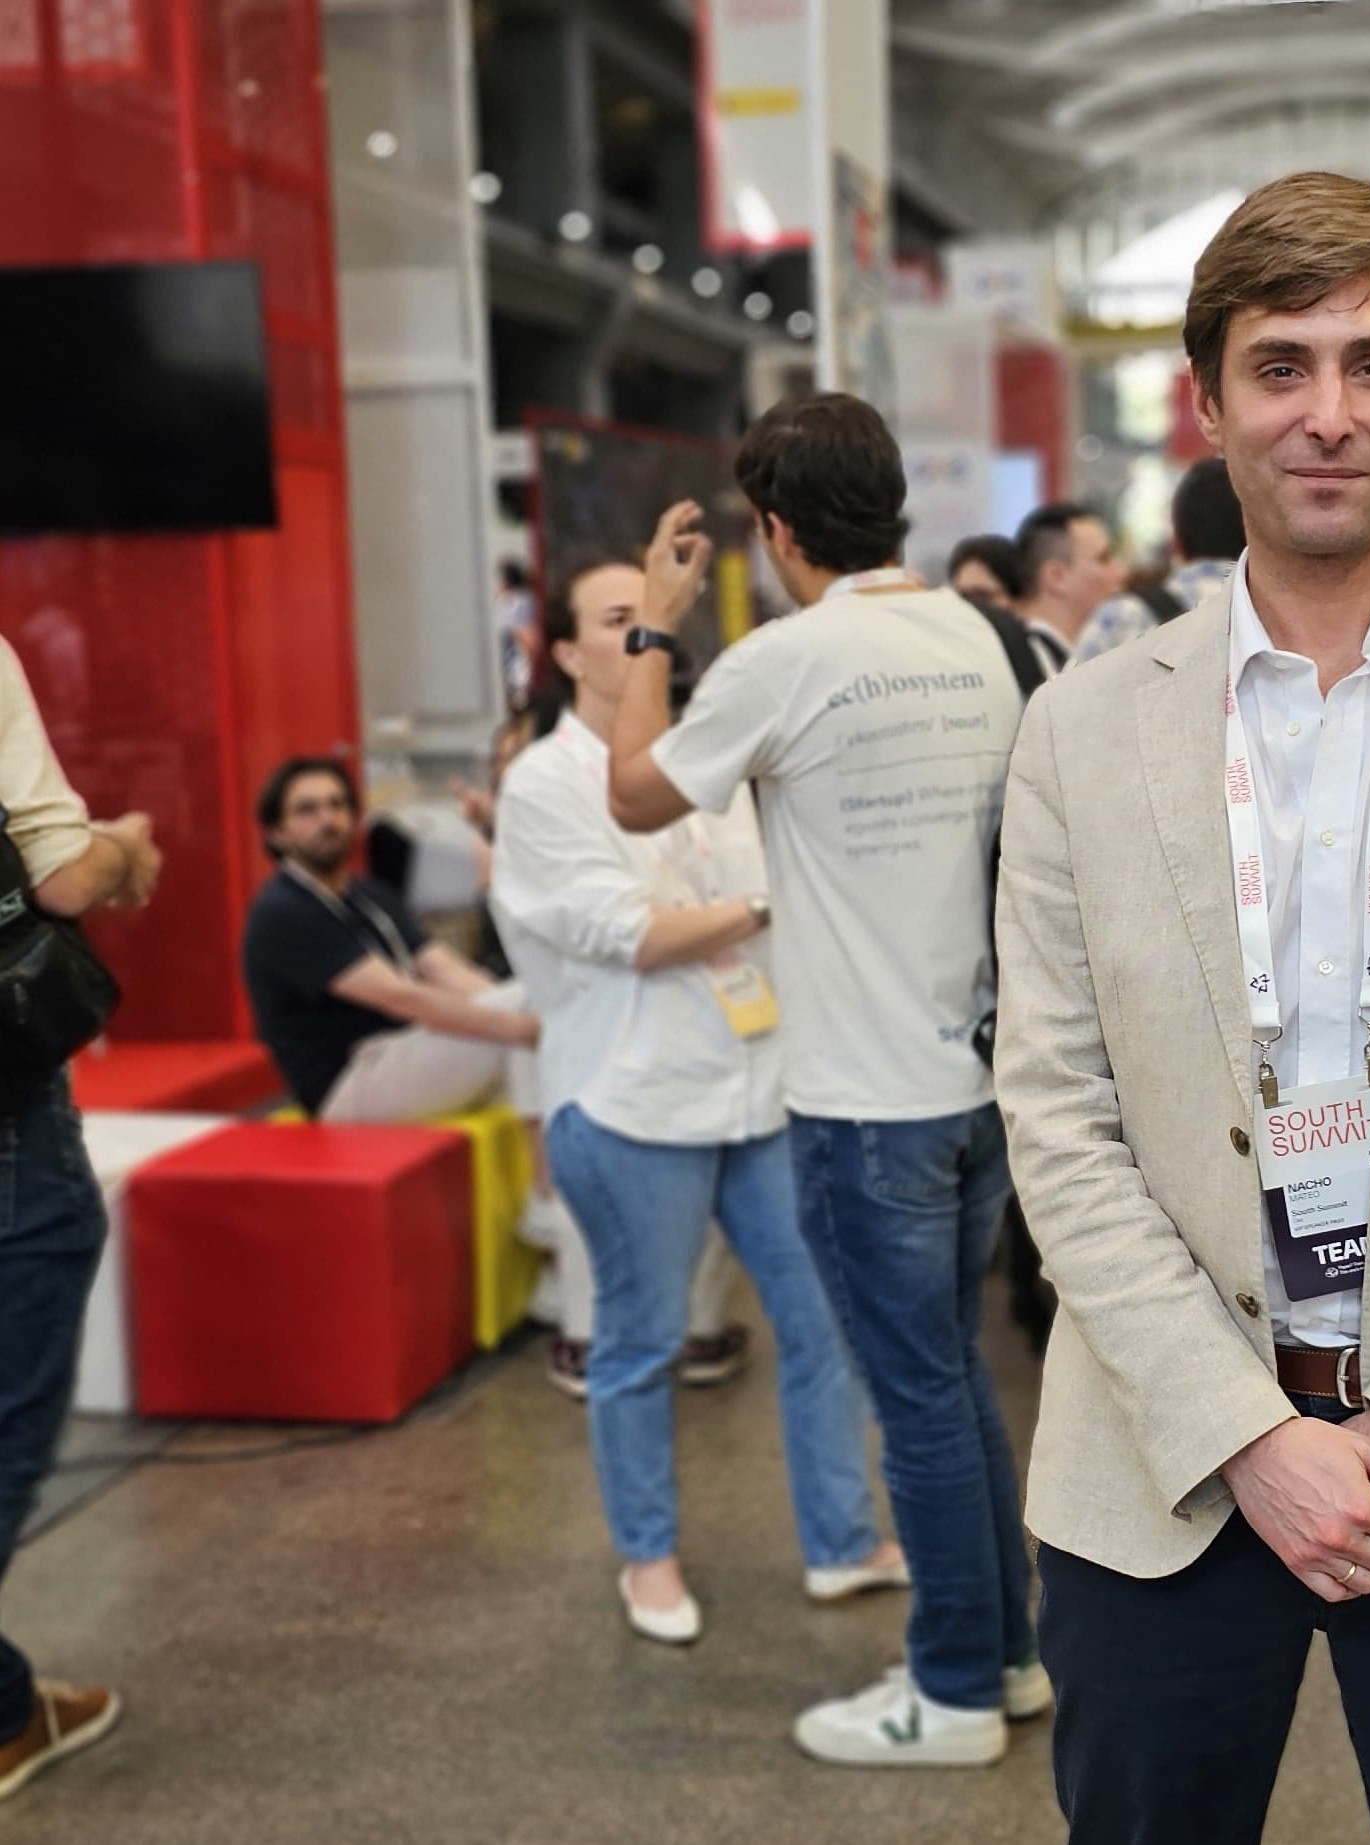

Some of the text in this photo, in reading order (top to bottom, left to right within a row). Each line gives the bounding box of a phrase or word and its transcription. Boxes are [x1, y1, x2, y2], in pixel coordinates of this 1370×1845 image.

[828, 671, 985, 708] ec(h)osystem
[1227, 763, 1241, 804] SOUTH
[1236, 758, 1252, 803] SUMMIT
[1239, 861, 1251, 906] SOUTH
[1248, 854, 1262, 905] SUMMIT
[1268, 1099, 1363, 1135] SOUTH
[1287, 1176, 1332, 1194] NACHO
